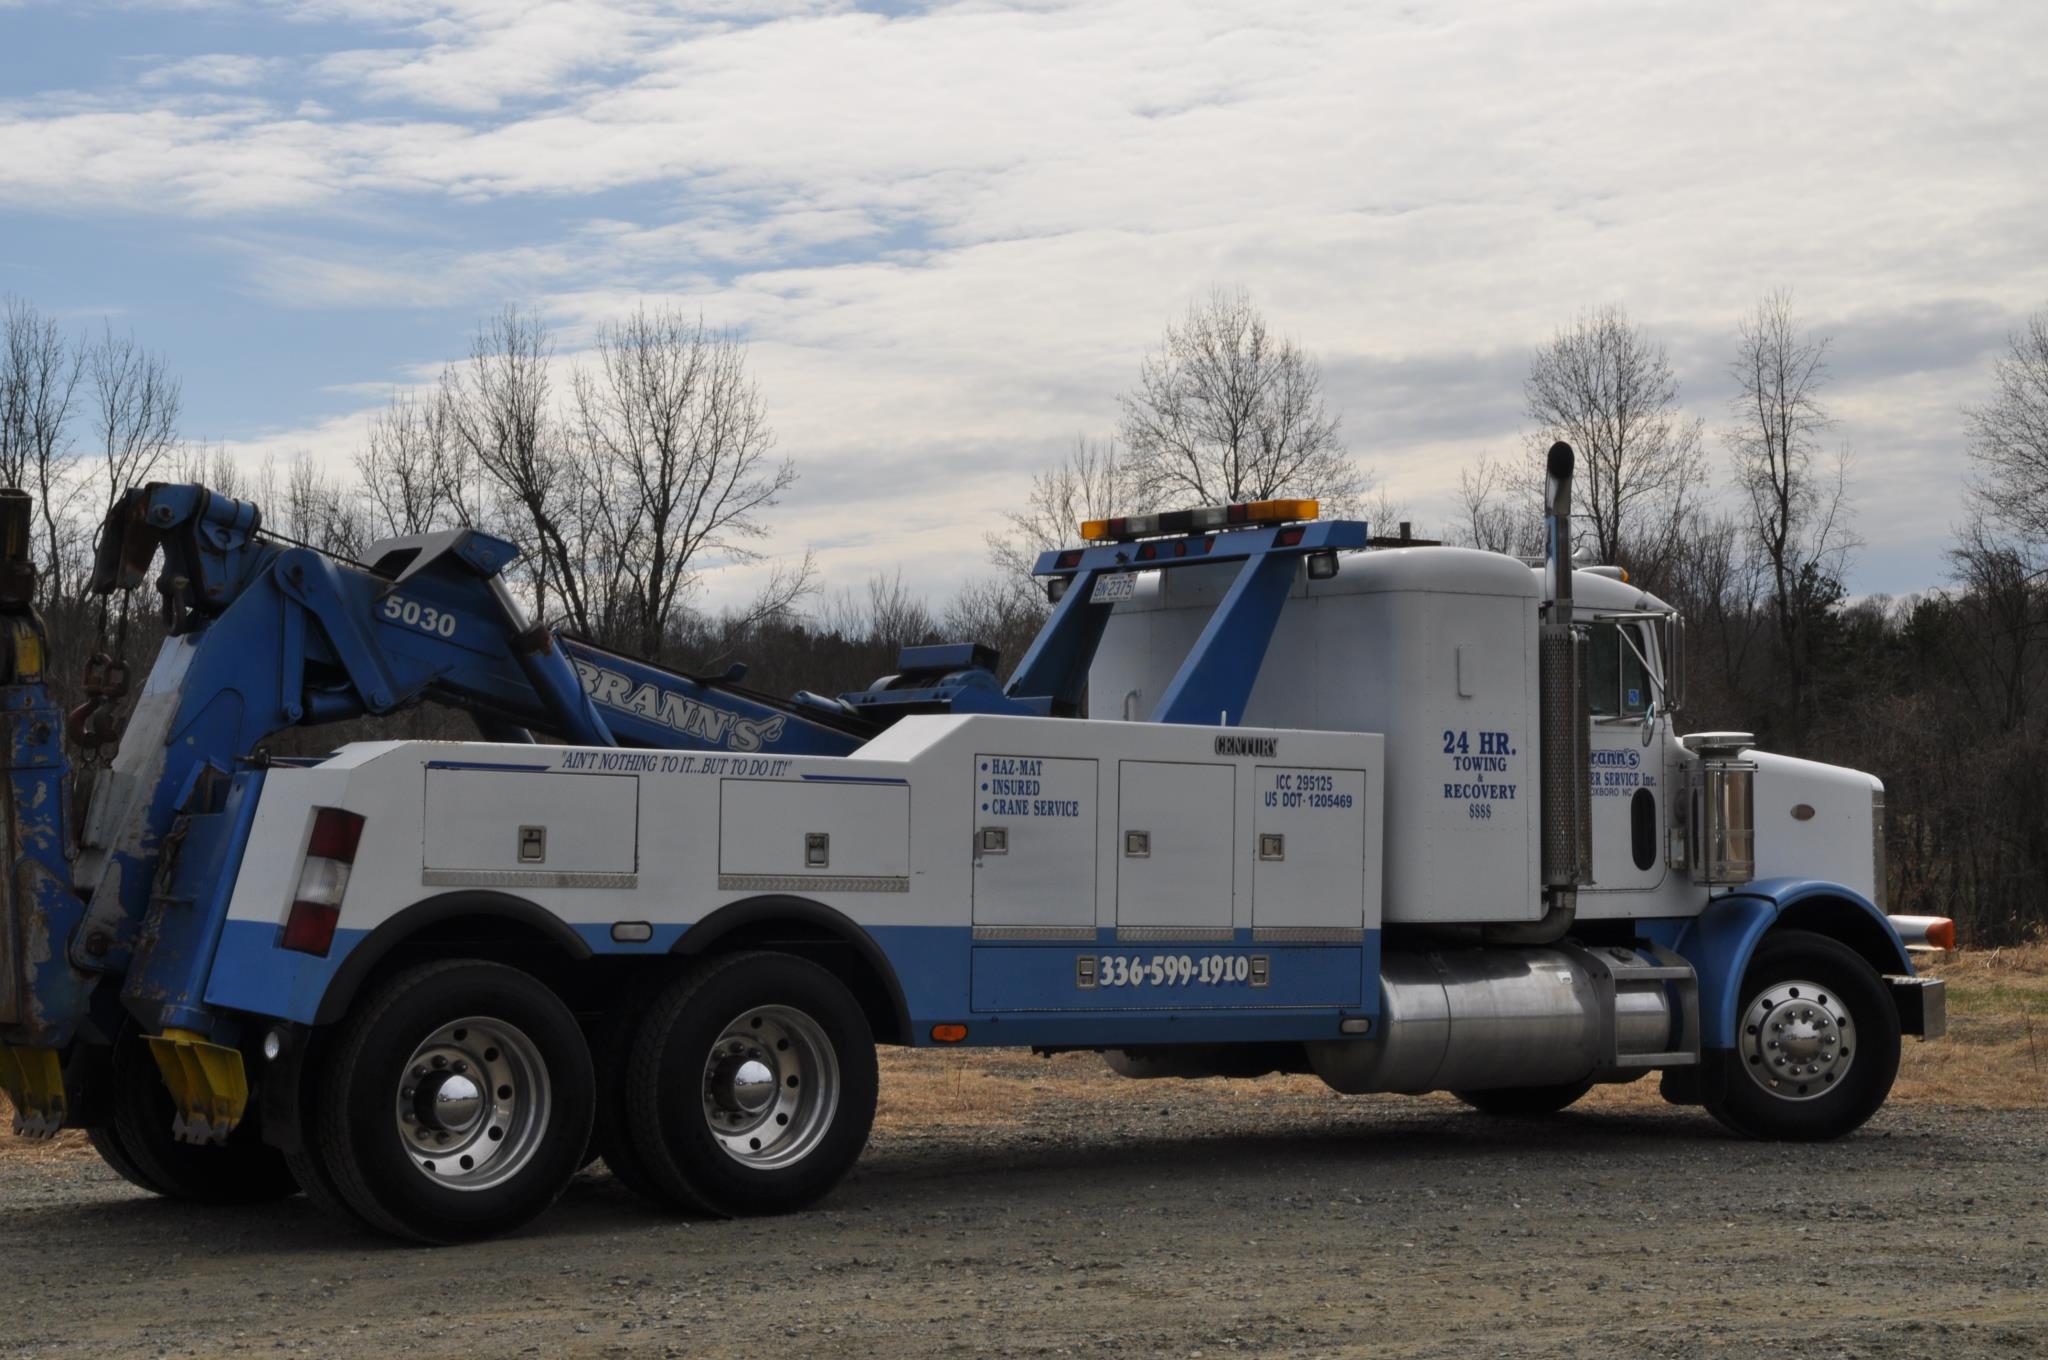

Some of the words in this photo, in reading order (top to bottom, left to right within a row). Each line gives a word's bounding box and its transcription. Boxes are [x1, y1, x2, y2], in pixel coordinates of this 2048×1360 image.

[383, 597, 457, 638] 5030
[1215, 735, 1278, 757] CENTURY
[1443, 730, 1469, 754] 24
[1479, 731, 1516, 755] HR.
[600, 753, 656, 772] NOTHING
[661, 755, 680, 773] TO
[730, 758, 748, 775] TO
[749, 759, 769, 776] DO
[992, 758, 1042, 777] HAZ-MAT
[1453, 756, 1507, 772] TOWING
[1591, 749, 1640, 769] rann's
[1276, 774, 1291, 790] ICC
[1297, 775, 1332, 791] 295125
[1477, 774, 1483, 783] &
[1591, 772, 1601, 786] ER
[1604, 772, 1639, 786] SERVICE
[1642, 773, 1657, 787] Inc.
[992, 779, 1040, 797] INSURED
[1444, 784, 1516, 799] RECOVERY
[1591, 787, 1620, 797] OXBORO
[1265, 791, 1277, 807] US
[992, 799, 1030, 817] CRANE
[1034, 801, 1079, 818] SERVICE
[1100, 955, 1249, 986] 336-599-1910
